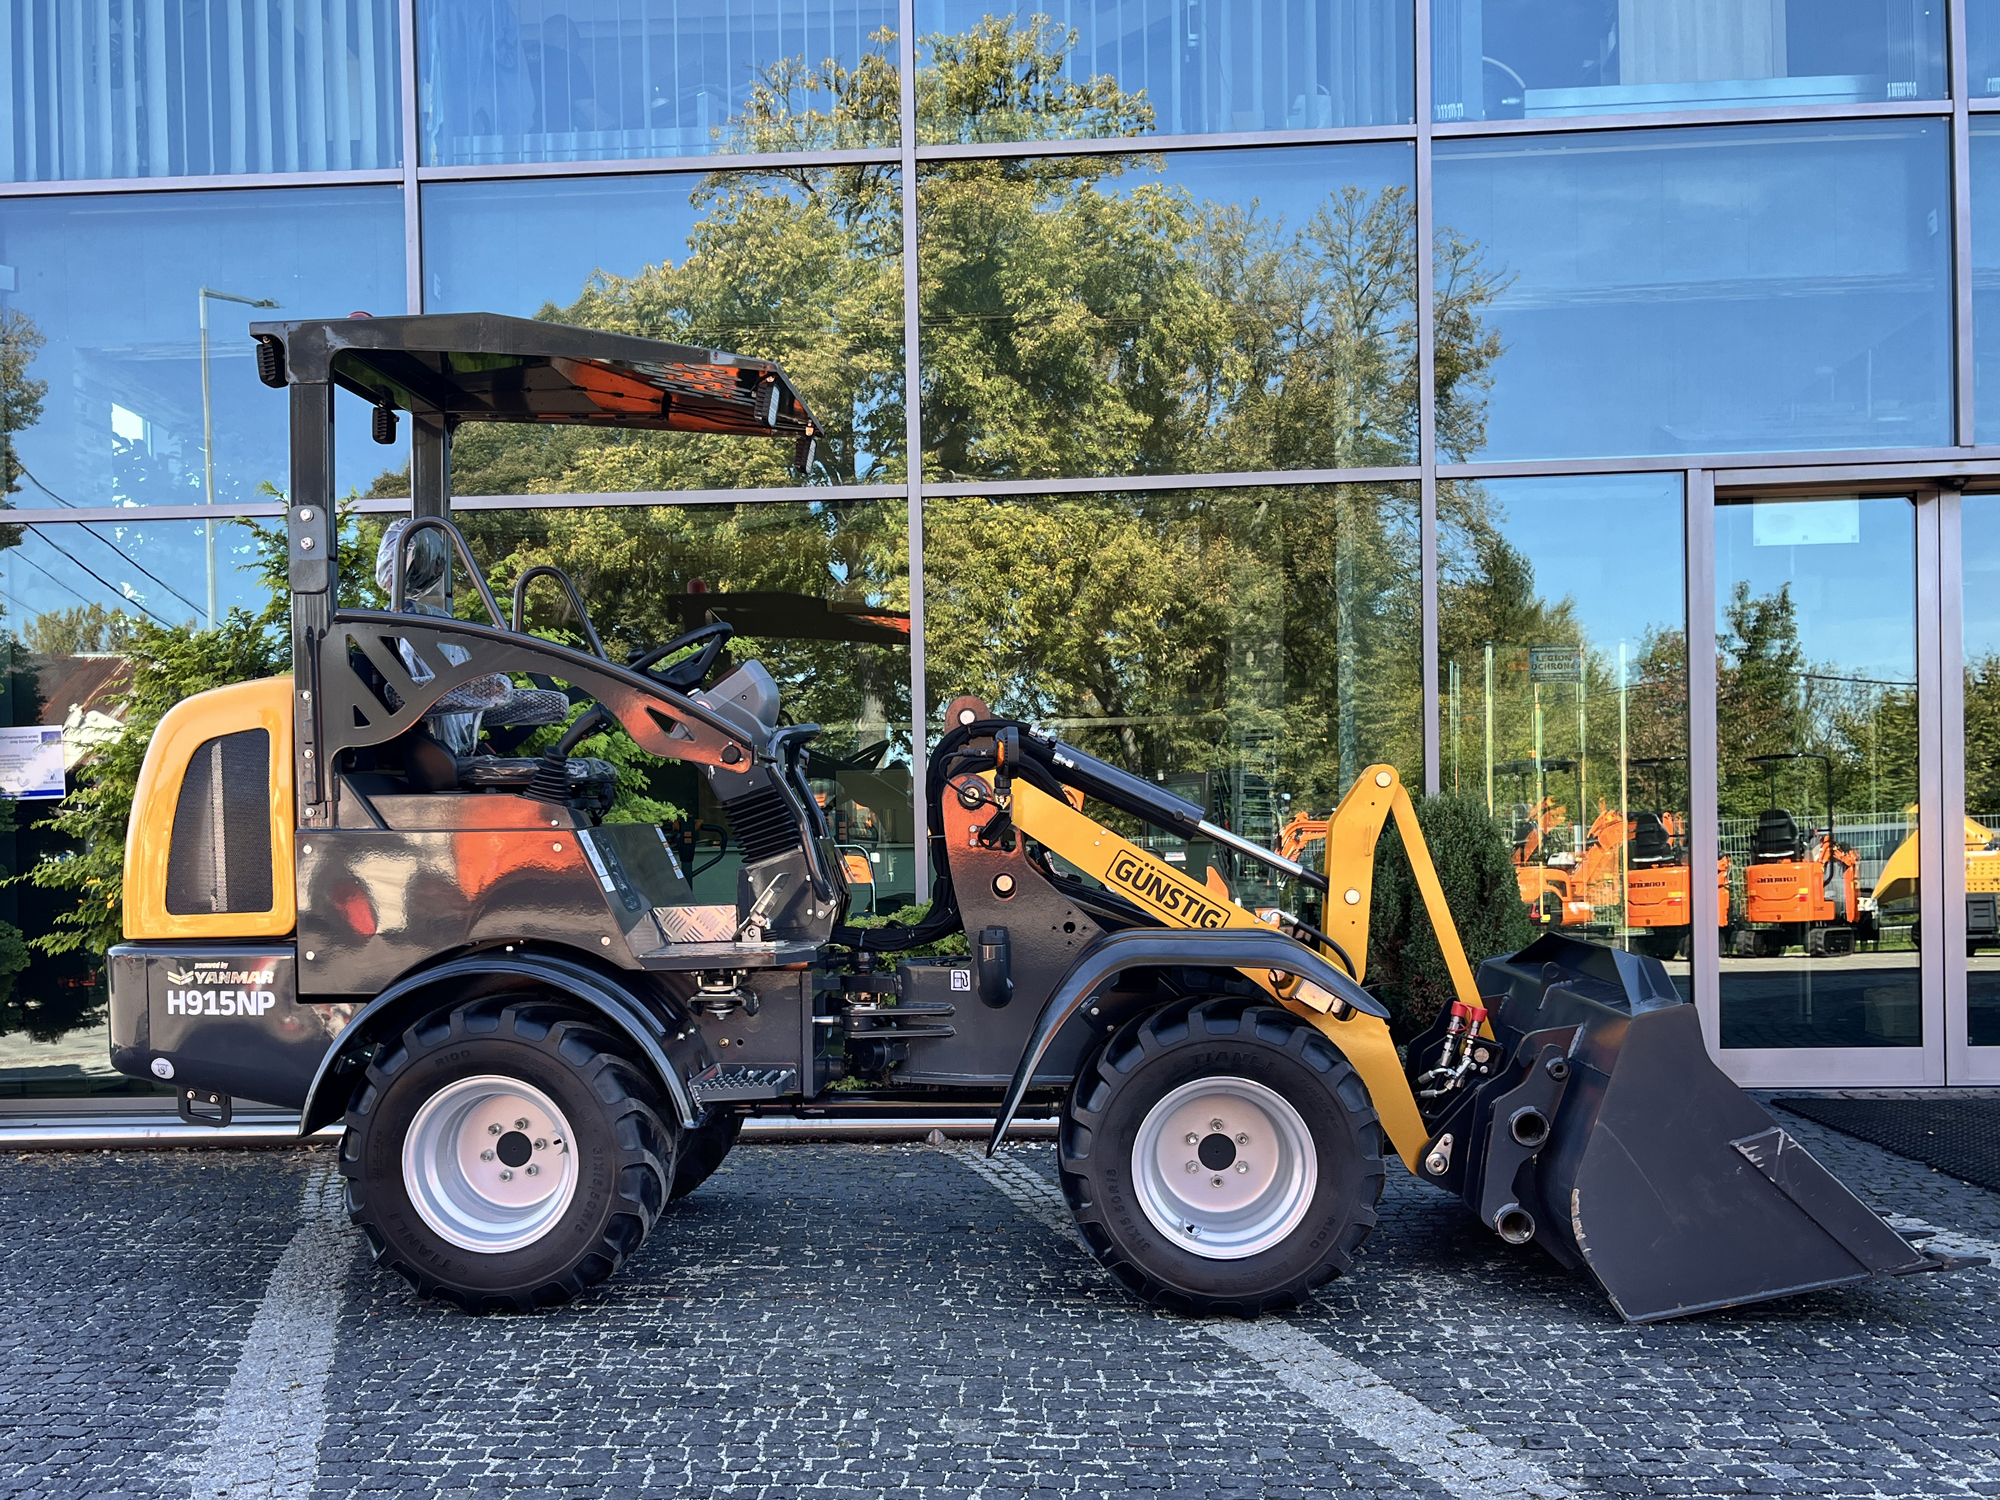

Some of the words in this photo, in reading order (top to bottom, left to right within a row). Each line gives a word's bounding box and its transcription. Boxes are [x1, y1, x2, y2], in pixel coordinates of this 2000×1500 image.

[1536, 654, 1572, 662] LEGION
[1115, 859, 1222, 928] GÜNSTIG
[194, 970, 275, 984] YANMAR
[167, 989, 276, 1016] H915NP
[1189, 1051, 1275, 1073] TIANLI
[387, 1211, 452, 1272] TIANLI
